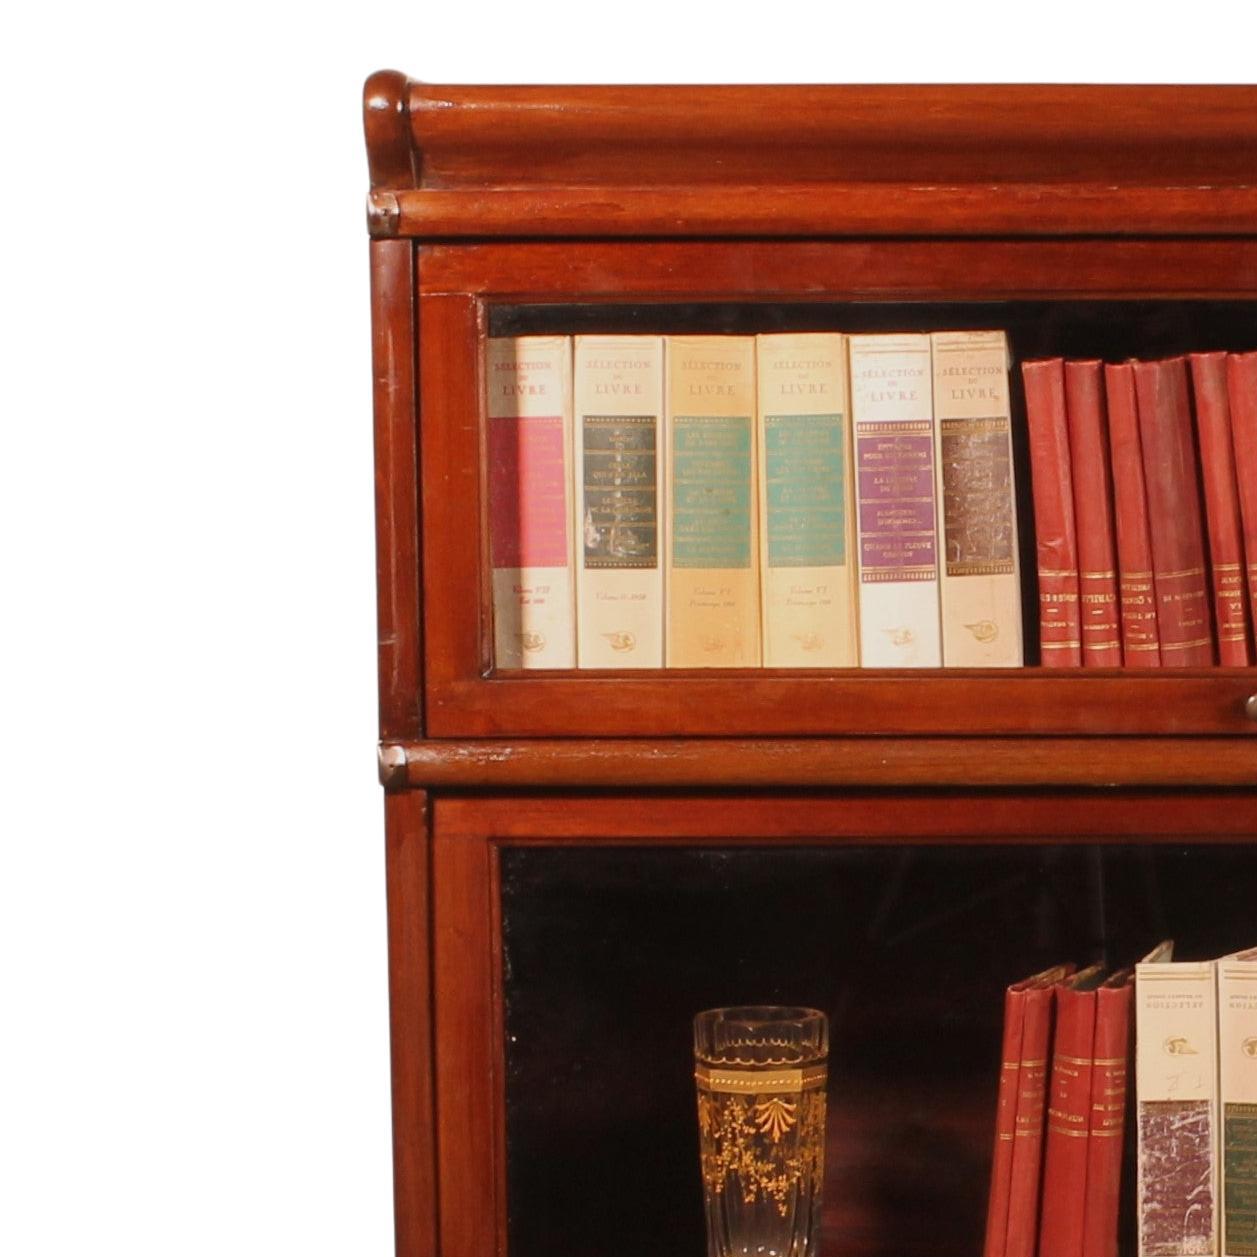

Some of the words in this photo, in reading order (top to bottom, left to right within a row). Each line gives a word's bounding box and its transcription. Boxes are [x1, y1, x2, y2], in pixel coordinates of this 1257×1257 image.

[943, 365, 1003, 376] SÉLECTION
[502, 384, 547, 396] LIVRE
[594, 383, 642, 395] LIVRE
[688, 384, 736, 396] LIVRE
[780, 383, 829, 395] LIVRE
[951, 387, 999, 401] LIVRE
[871, 390, 920, 402] LIVRE
